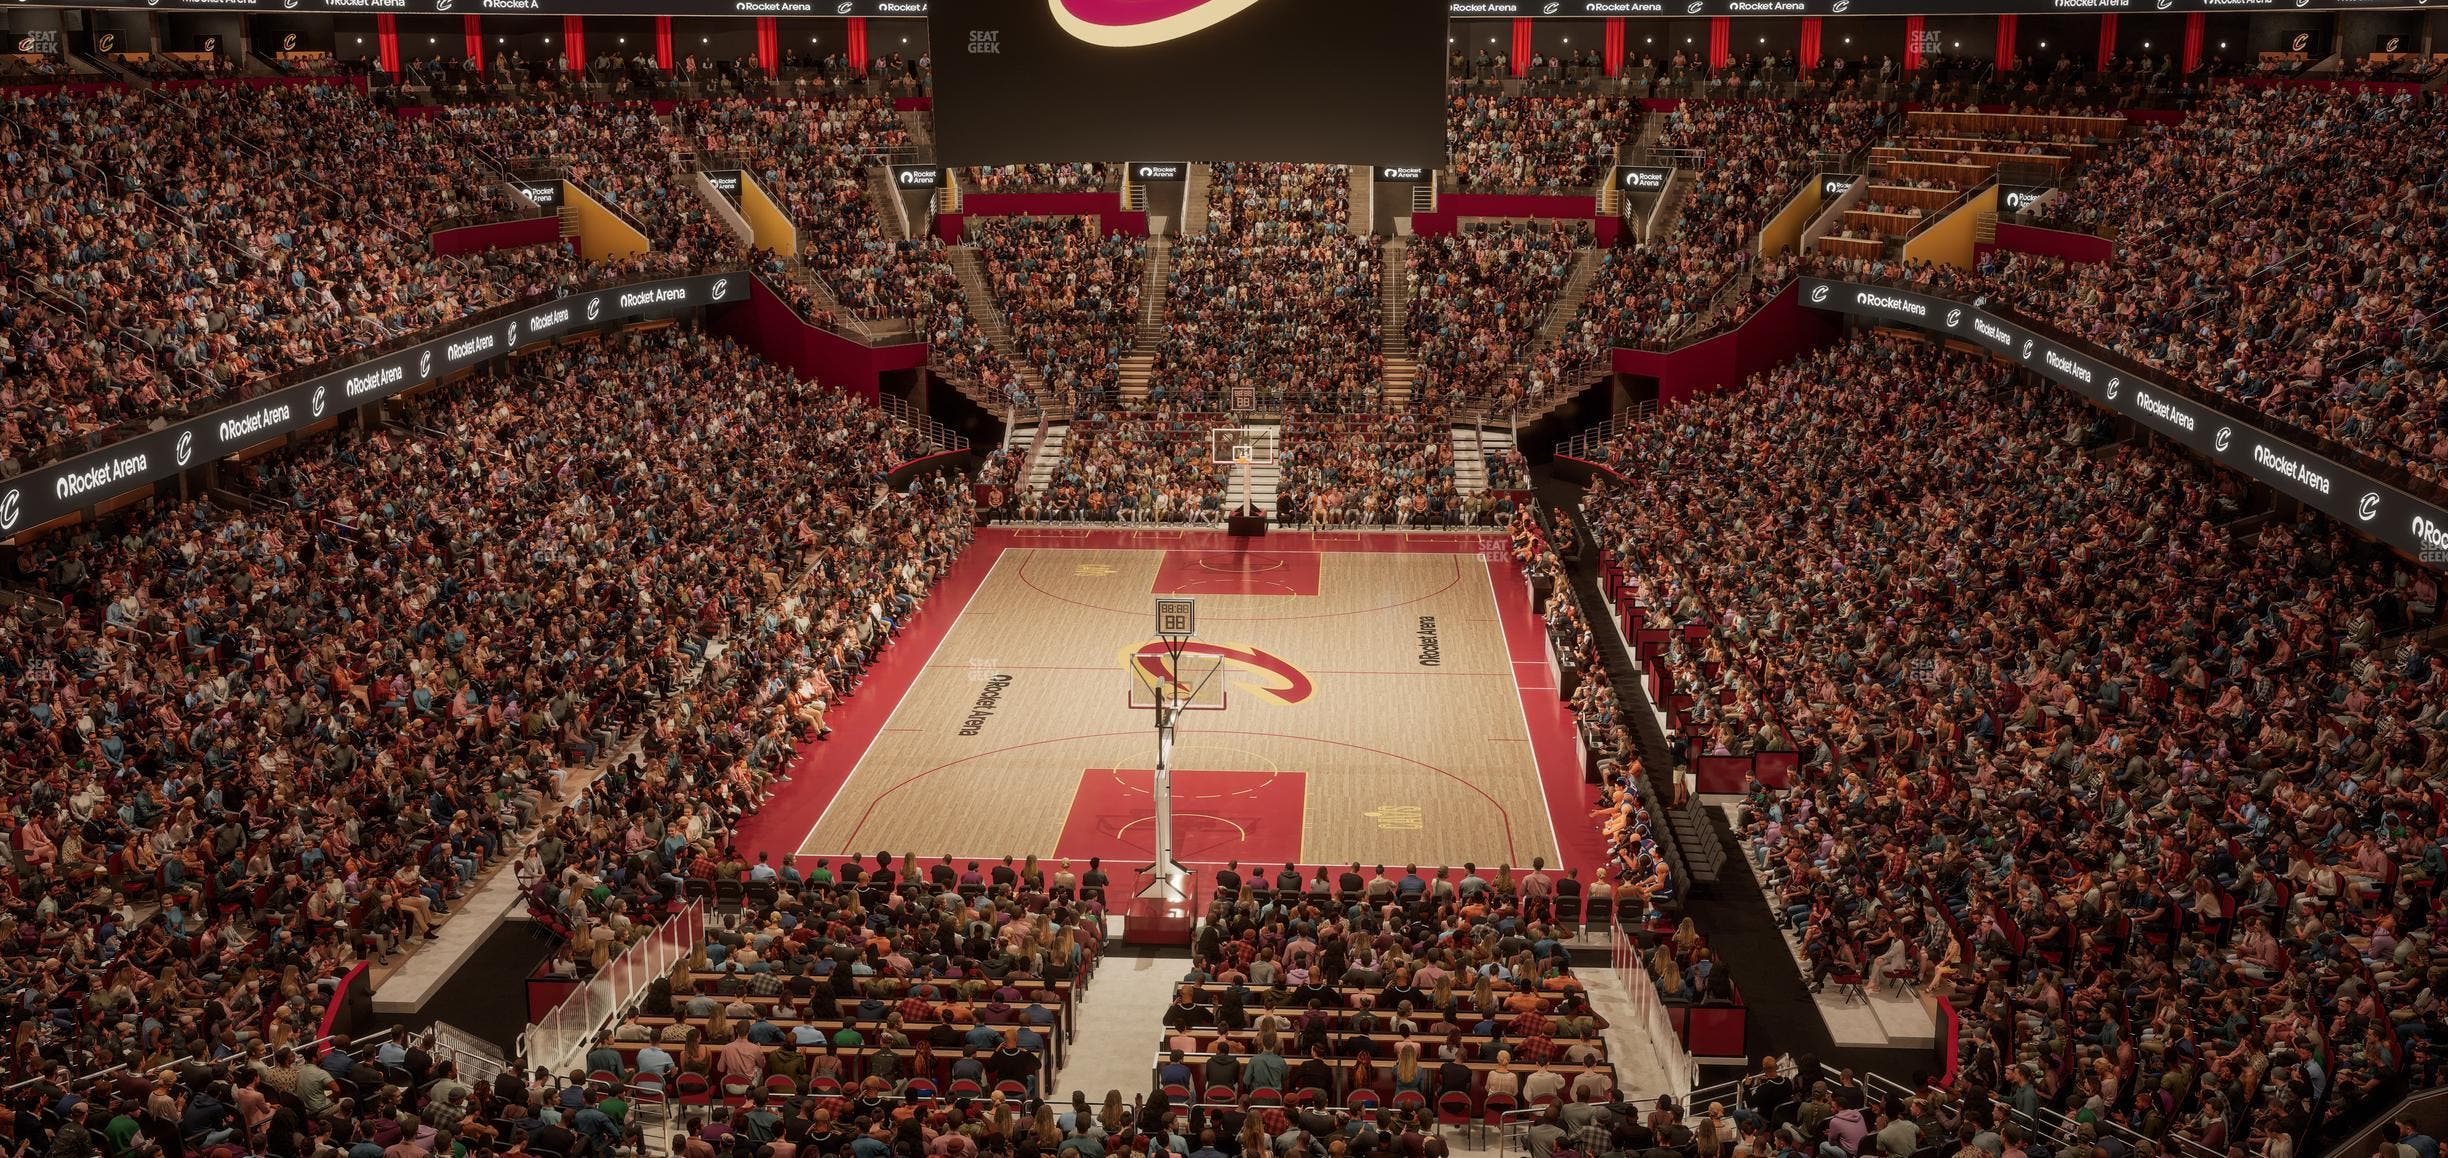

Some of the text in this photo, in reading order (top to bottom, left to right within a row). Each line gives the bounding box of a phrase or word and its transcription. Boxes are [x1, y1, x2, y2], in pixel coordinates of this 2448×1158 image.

[493, 0, 539, 8] Rocket A
[745, 2, 811, 11] Rocket Arena
[887, 3, 921, 12] Rocket
[1453, 3, 1517, 12] Rocket Arena
[1595, 3, 1662, 11] Rocket Arena
[1739, 2, 1805, 10] Rocket Arena
[1639, 173, 1663, 181] Rocket
[627, 287, 686, 308] Rocket Arena
[1868, 293, 1926, 316] Rocket Arena
[535, 309, 569, 331] Rocket Arena
[1979, 320, 2011, 346] Rocket Arena
[453, 333, 494, 361] Rocket Arena
[2053, 352, 2092, 384] Rocket Arena
[354, 364, 403, 396] Rocket Arena
[229, 405, 290, 440] Rocket Arena
[2143, 393, 2195, 431] Rocket Arena
[68, 454, 148, 496] Rocket Arena
[2263, 448, 2330, 495] Rocket Arena
[1161, 604, 1189, 613] 88:88
[1166, 615, 1185, 630] 88
[1416, 616, 1440, 660] Rocket Arena
[958, 681, 1010, 736] Rocket Arena
